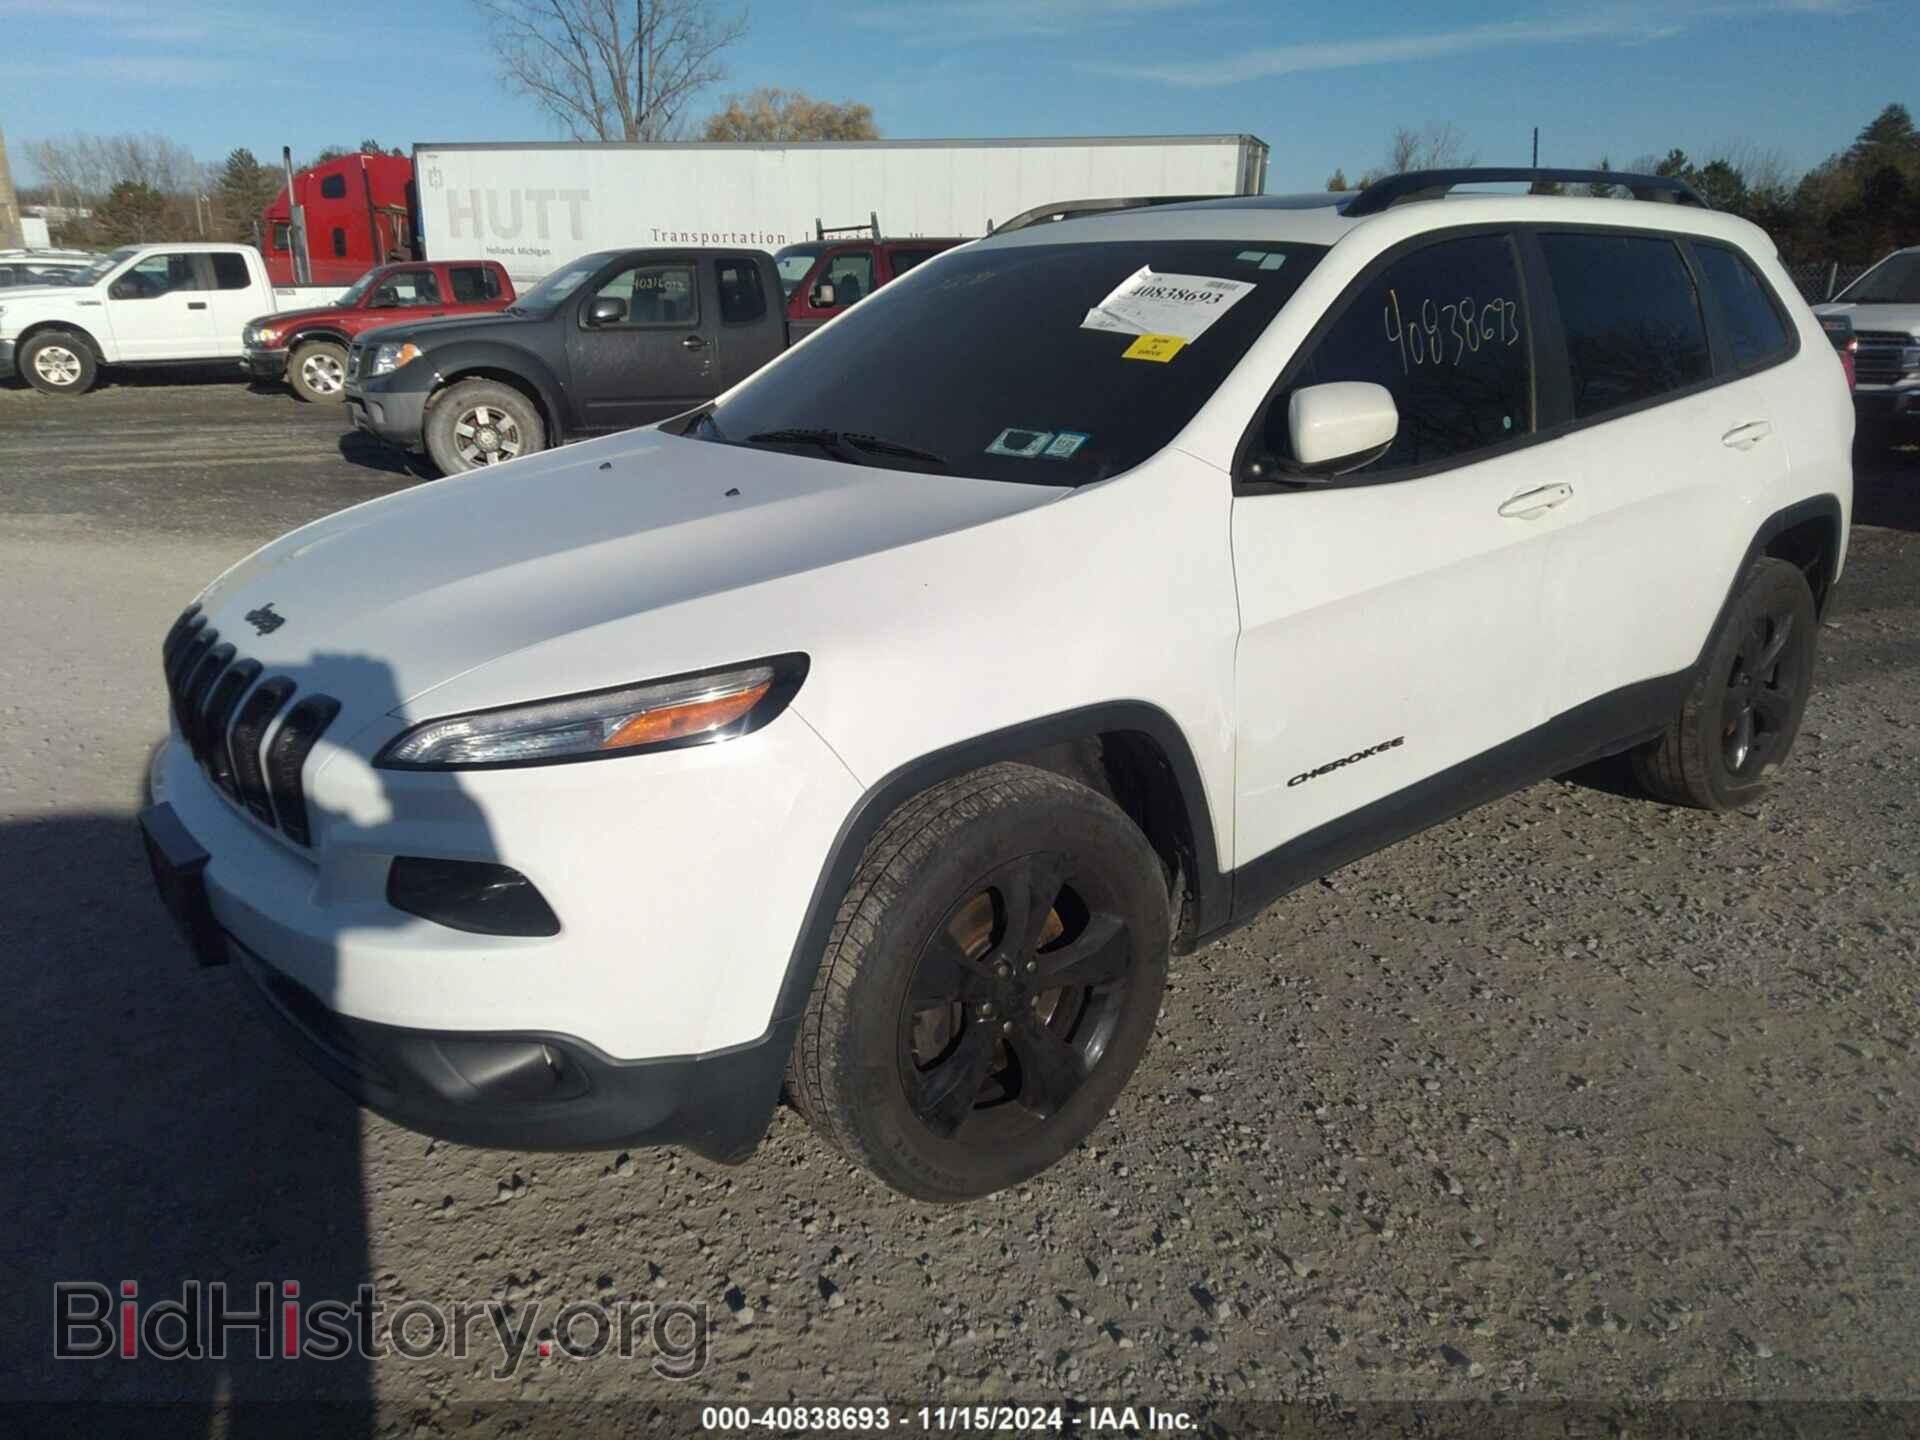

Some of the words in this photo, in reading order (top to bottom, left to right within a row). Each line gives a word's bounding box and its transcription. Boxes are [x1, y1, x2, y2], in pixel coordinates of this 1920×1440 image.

[447, 188, 591, 240] HUTT
[518, 247, 552, 258] Michigan
[1130, 284, 1225, 305] 40838693
[1384, 288, 1520, 377] 40838693
[1287, 736, 1405, 788] CHEROKEE
